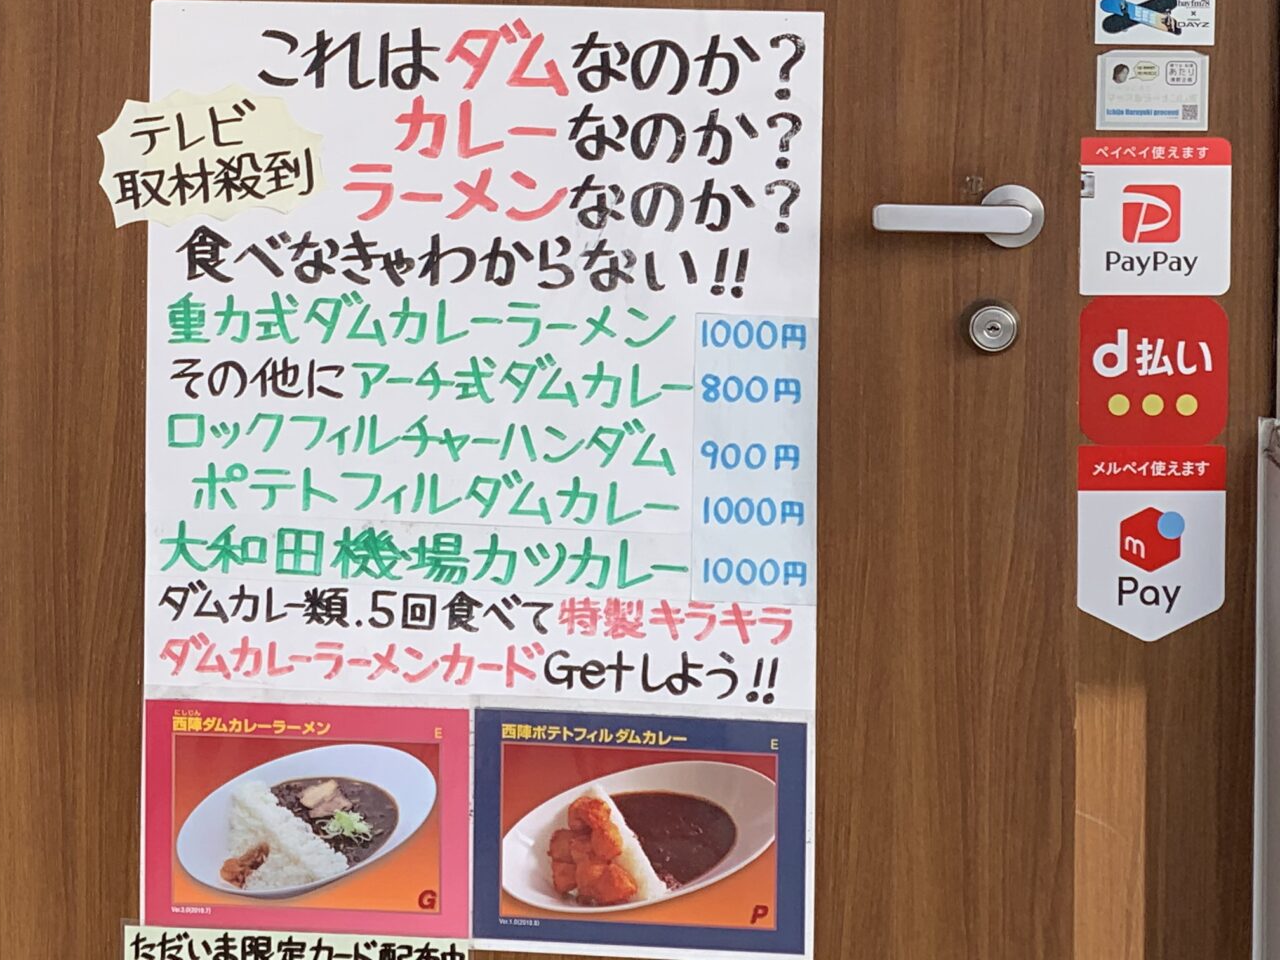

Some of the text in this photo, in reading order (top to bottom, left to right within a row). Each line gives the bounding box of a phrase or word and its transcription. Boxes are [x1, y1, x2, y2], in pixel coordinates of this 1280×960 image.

[257, 16, 808, 101] これはダムなのか?
[130, 98, 257, 155] テレビ
[394, 95, 804, 170] カレーなのか?
[1095, 146, 1209, 160] ペイペイ使えます
[115, 153, 314, 209] 取材殺到
[342, 162, 802, 235] ラーメンなのか?
[176, 224, 750, 298] 食べなきゃわからない!!
[1105, 251, 1198, 276] PayPay
[166, 286, 807, 352] 重力式ダムカレーラーメン 1000円
[169, 353, 802, 410] その他にアーチ式ダムカレー 800円
[1092, 328, 1213, 378] d払い
[167, 412, 801, 476] ロックフィルチャーハンダム 900円
[1092, 460, 1211, 477] メルペイ使えます
[192, 462, 805, 526] ポテトフィルダムカレー 1000円
[159, 521, 808, 590] 大和田機場カツカレー 1000円
[1118, 576, 1182, 614] Pay
[160, 633, 779, 705] ダムカレーラーメンカードGetしよう!!
[172, 715, 443, 739] 西陣ダムカレーラーメン E
[770, 738, 779, 751] E
[417, 889, 438, 911] G
[750, 903, 768, 924] P
